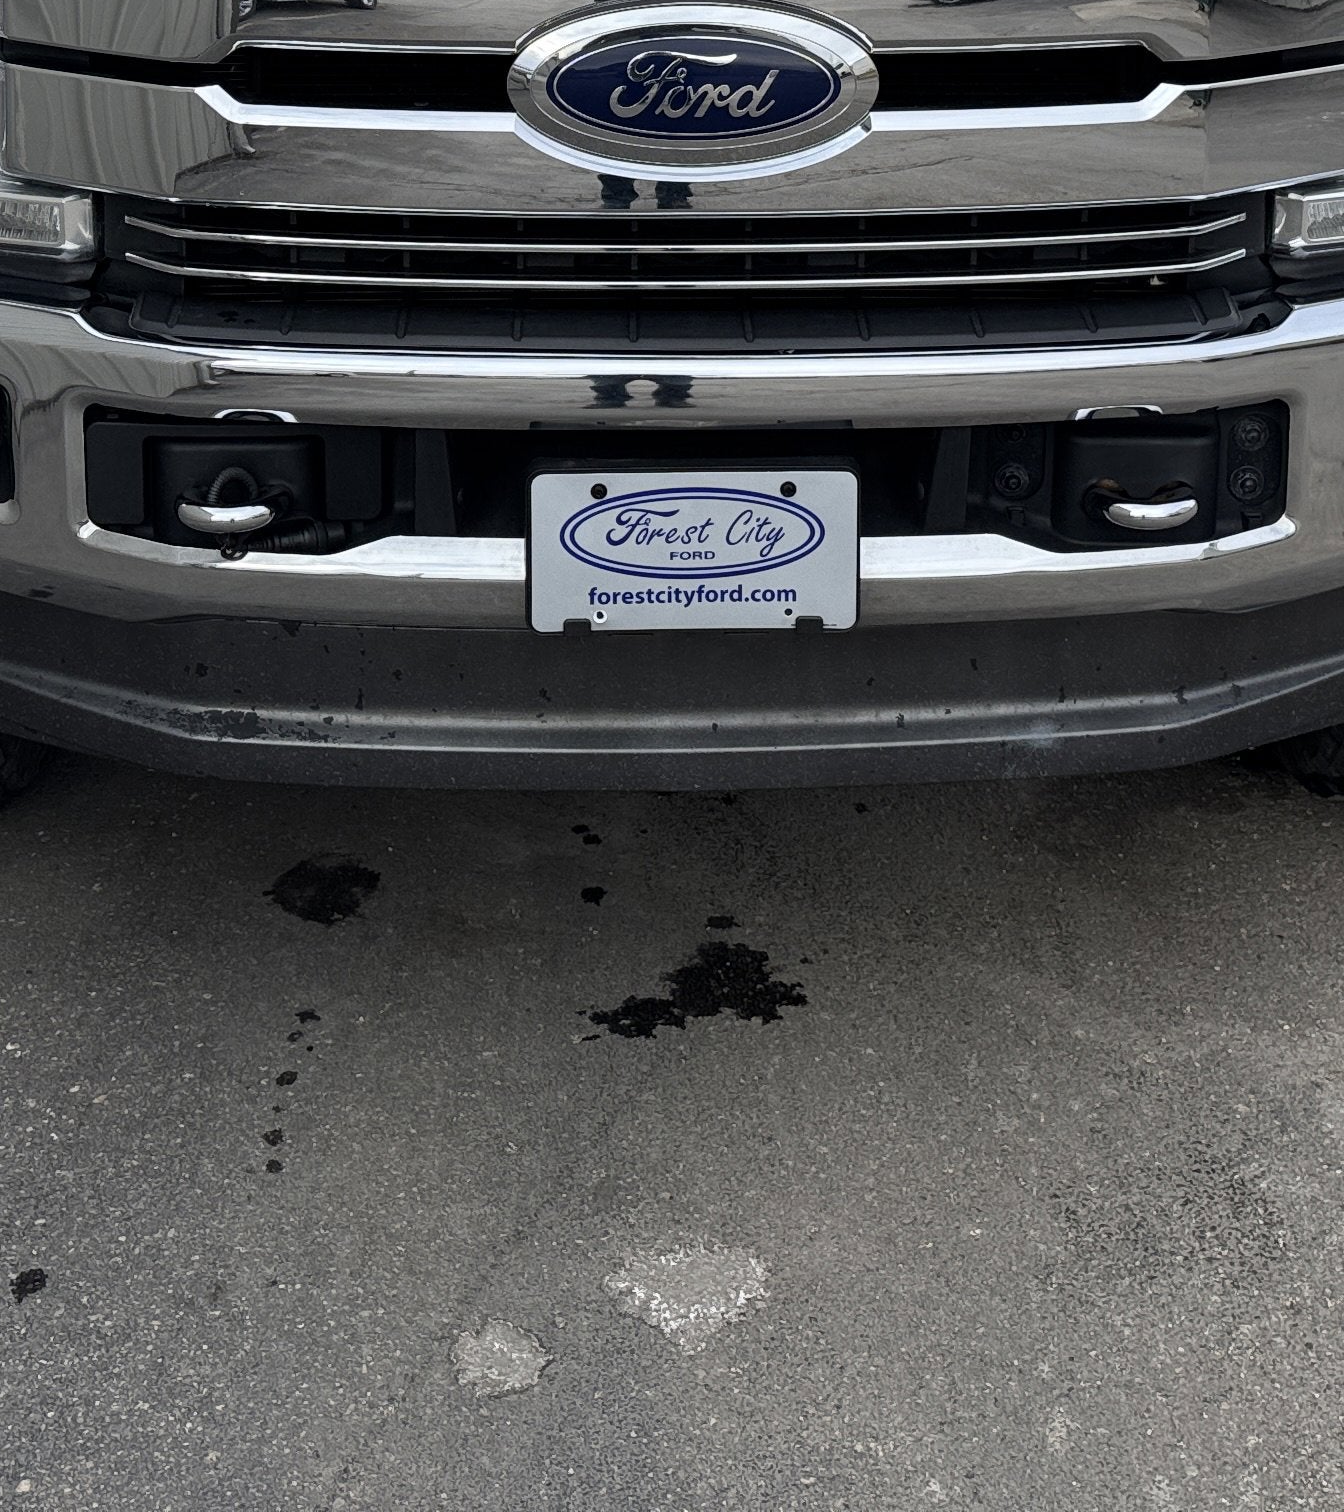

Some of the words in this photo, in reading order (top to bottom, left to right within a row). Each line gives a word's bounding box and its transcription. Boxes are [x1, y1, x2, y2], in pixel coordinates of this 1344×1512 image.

[609, 50, 778, 119] Ford
[605, 509, 714, 547] Forest
[725, 509, 786, 558] City
[669, 550, 716, 561] FORD
[588, 584, 798, 609] forestcityford.com
